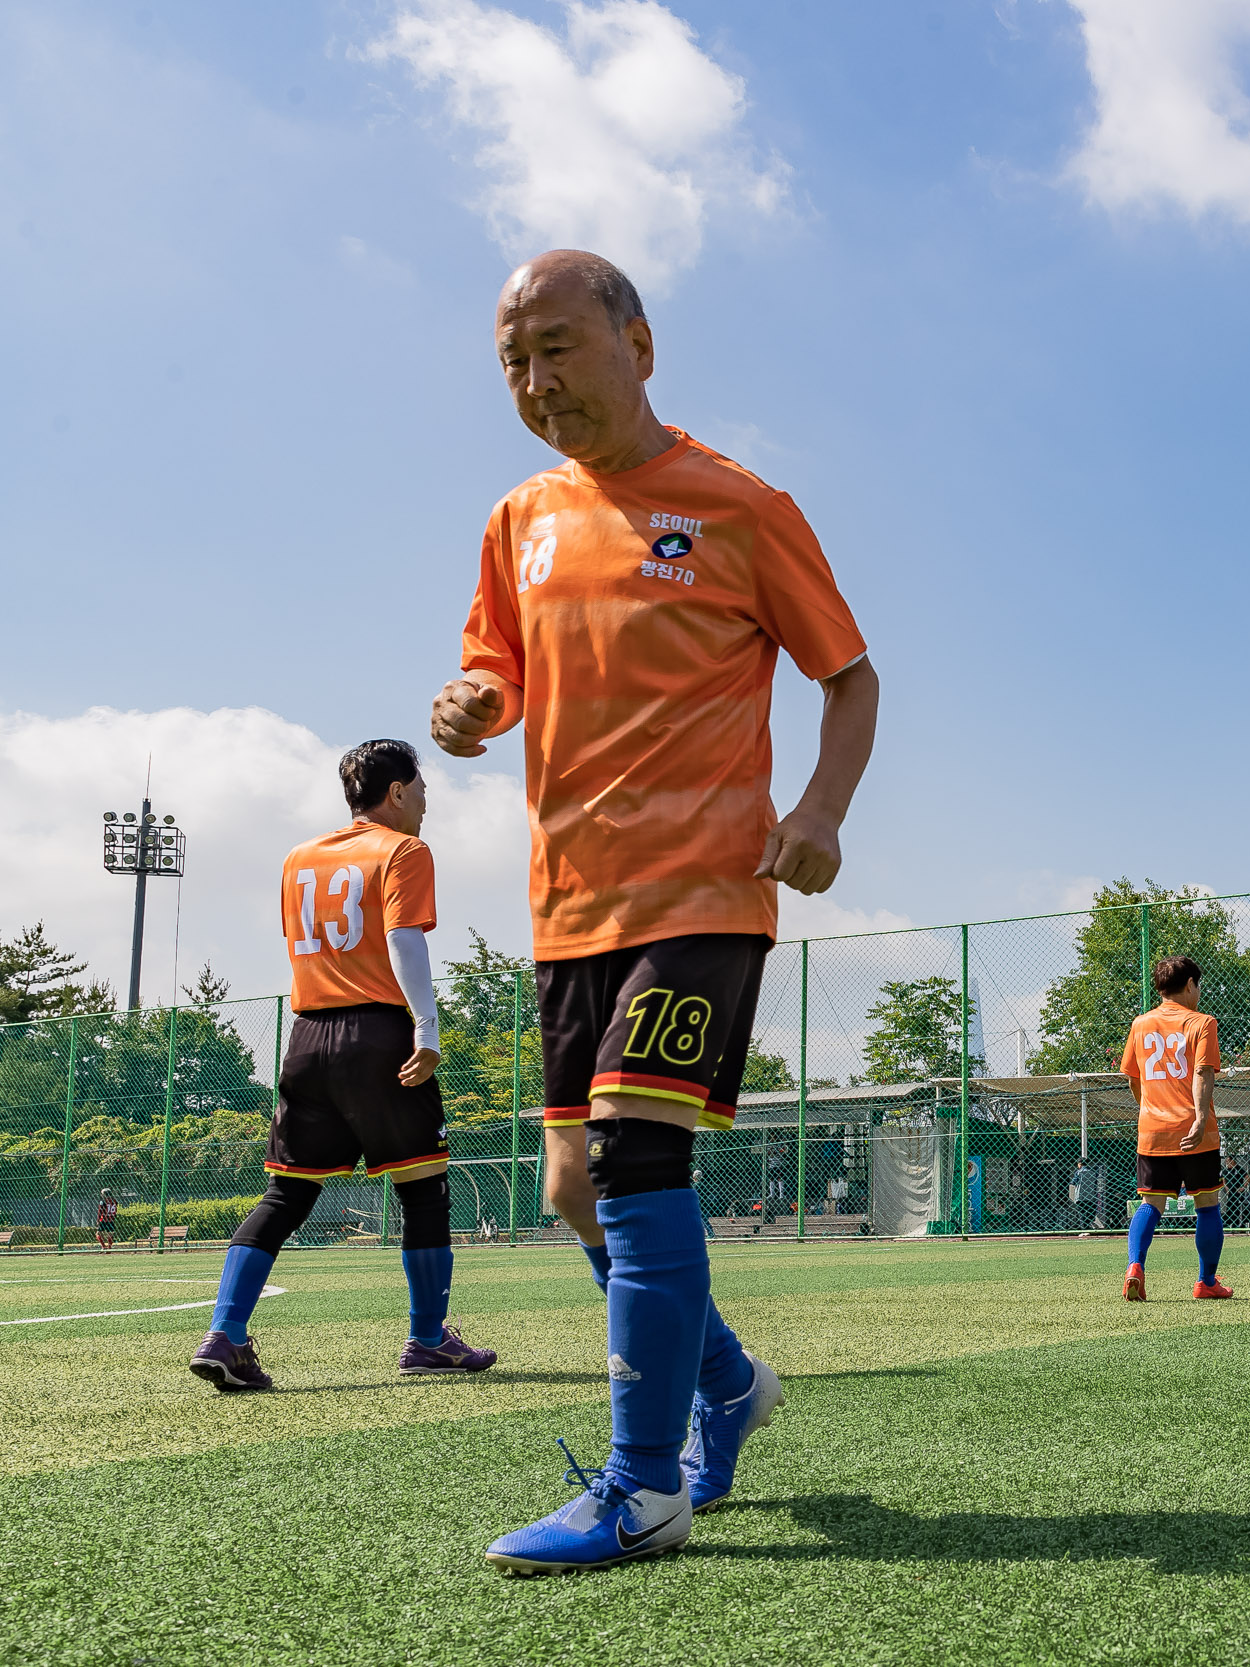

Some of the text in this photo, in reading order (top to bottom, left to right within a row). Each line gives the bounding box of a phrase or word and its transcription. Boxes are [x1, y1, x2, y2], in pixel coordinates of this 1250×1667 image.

[650, 513, 703, 537] SEOUL
[518, 534, 557, 594] 18
[641, 560, 695, 586] 광진70
[294, 864, 364, 956] 13
[623, 988, 711, 1065] 18
[1143, 1031, 1188, 1080] 23
